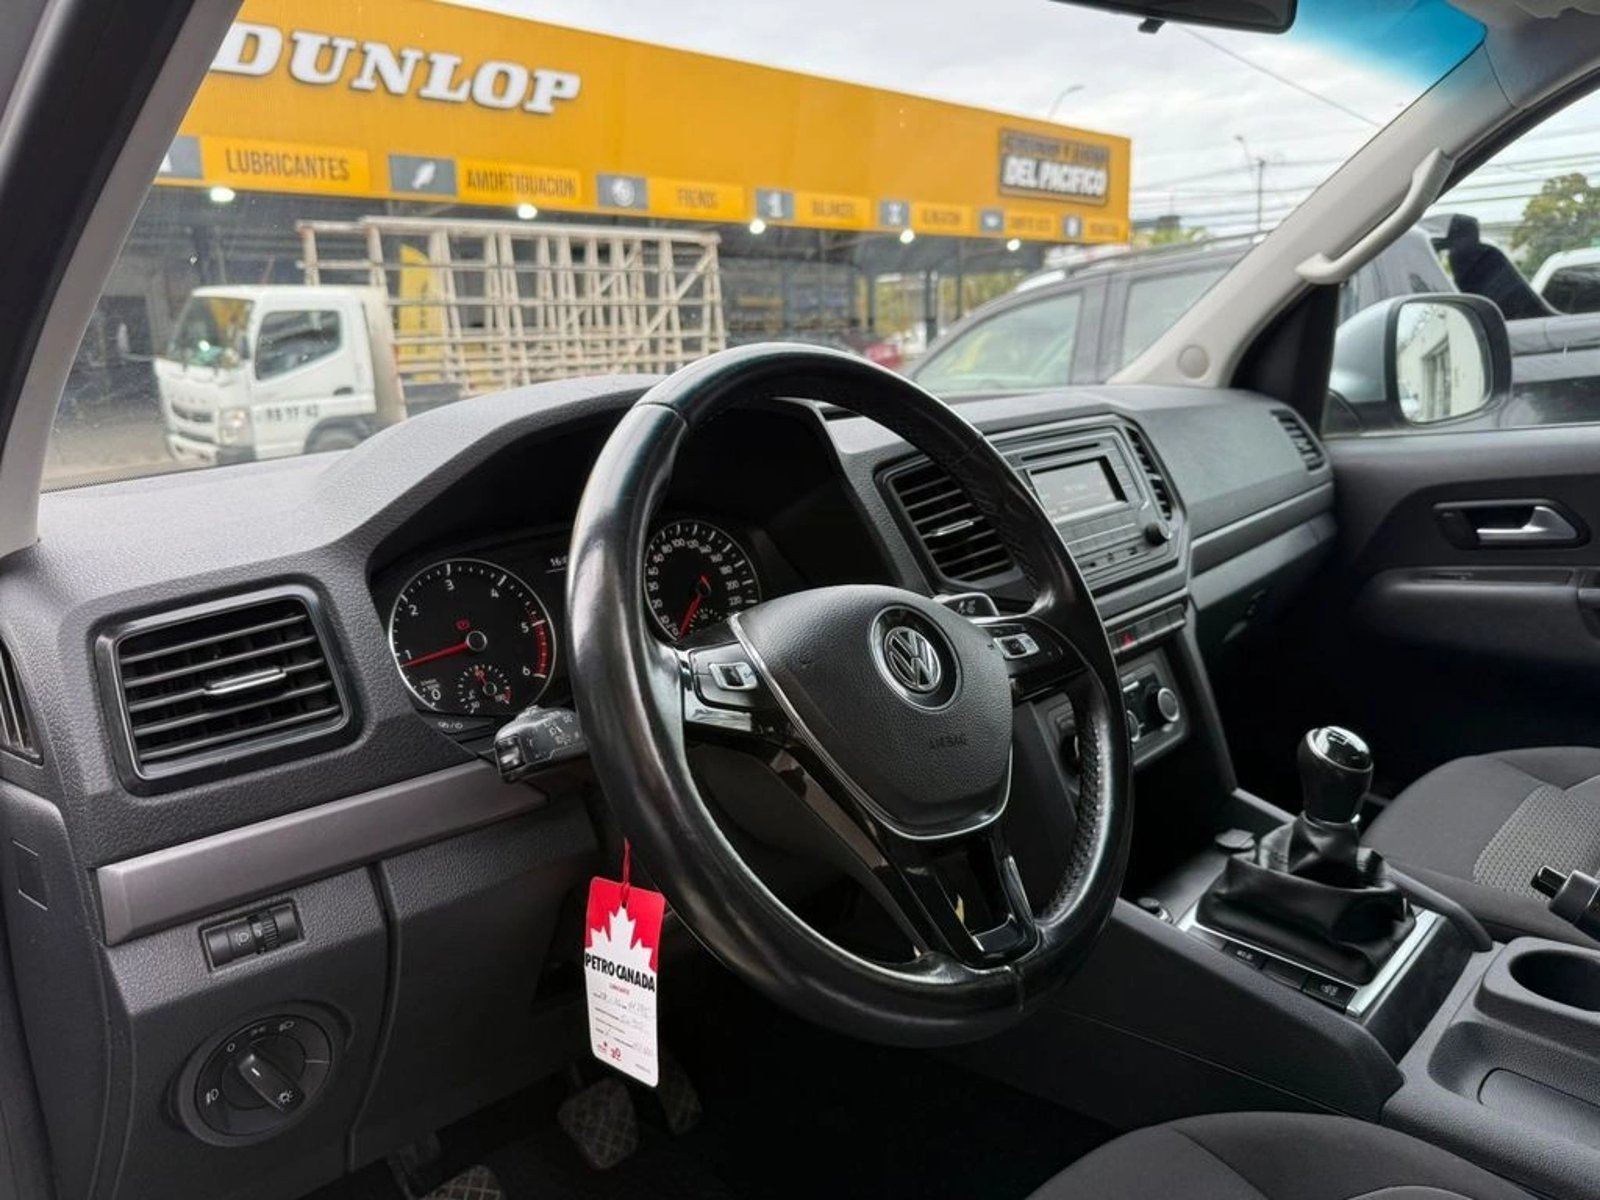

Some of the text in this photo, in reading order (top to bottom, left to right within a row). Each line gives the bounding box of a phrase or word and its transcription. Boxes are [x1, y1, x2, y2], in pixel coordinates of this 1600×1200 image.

[209, 21, 582, 114] DUNLOP
[225, 147, 351, 182] LUBRICANTES
[1003, 155, 1037, 187] DEL
[445, 580, 455, 591] 3
[491, 589, 499, 598] 4
[409, 605, 419, 616] 2
[521, 622, 529, 633] 5
[522, 666, 531, 676] 6
[431, 688, 441, 700] 0
